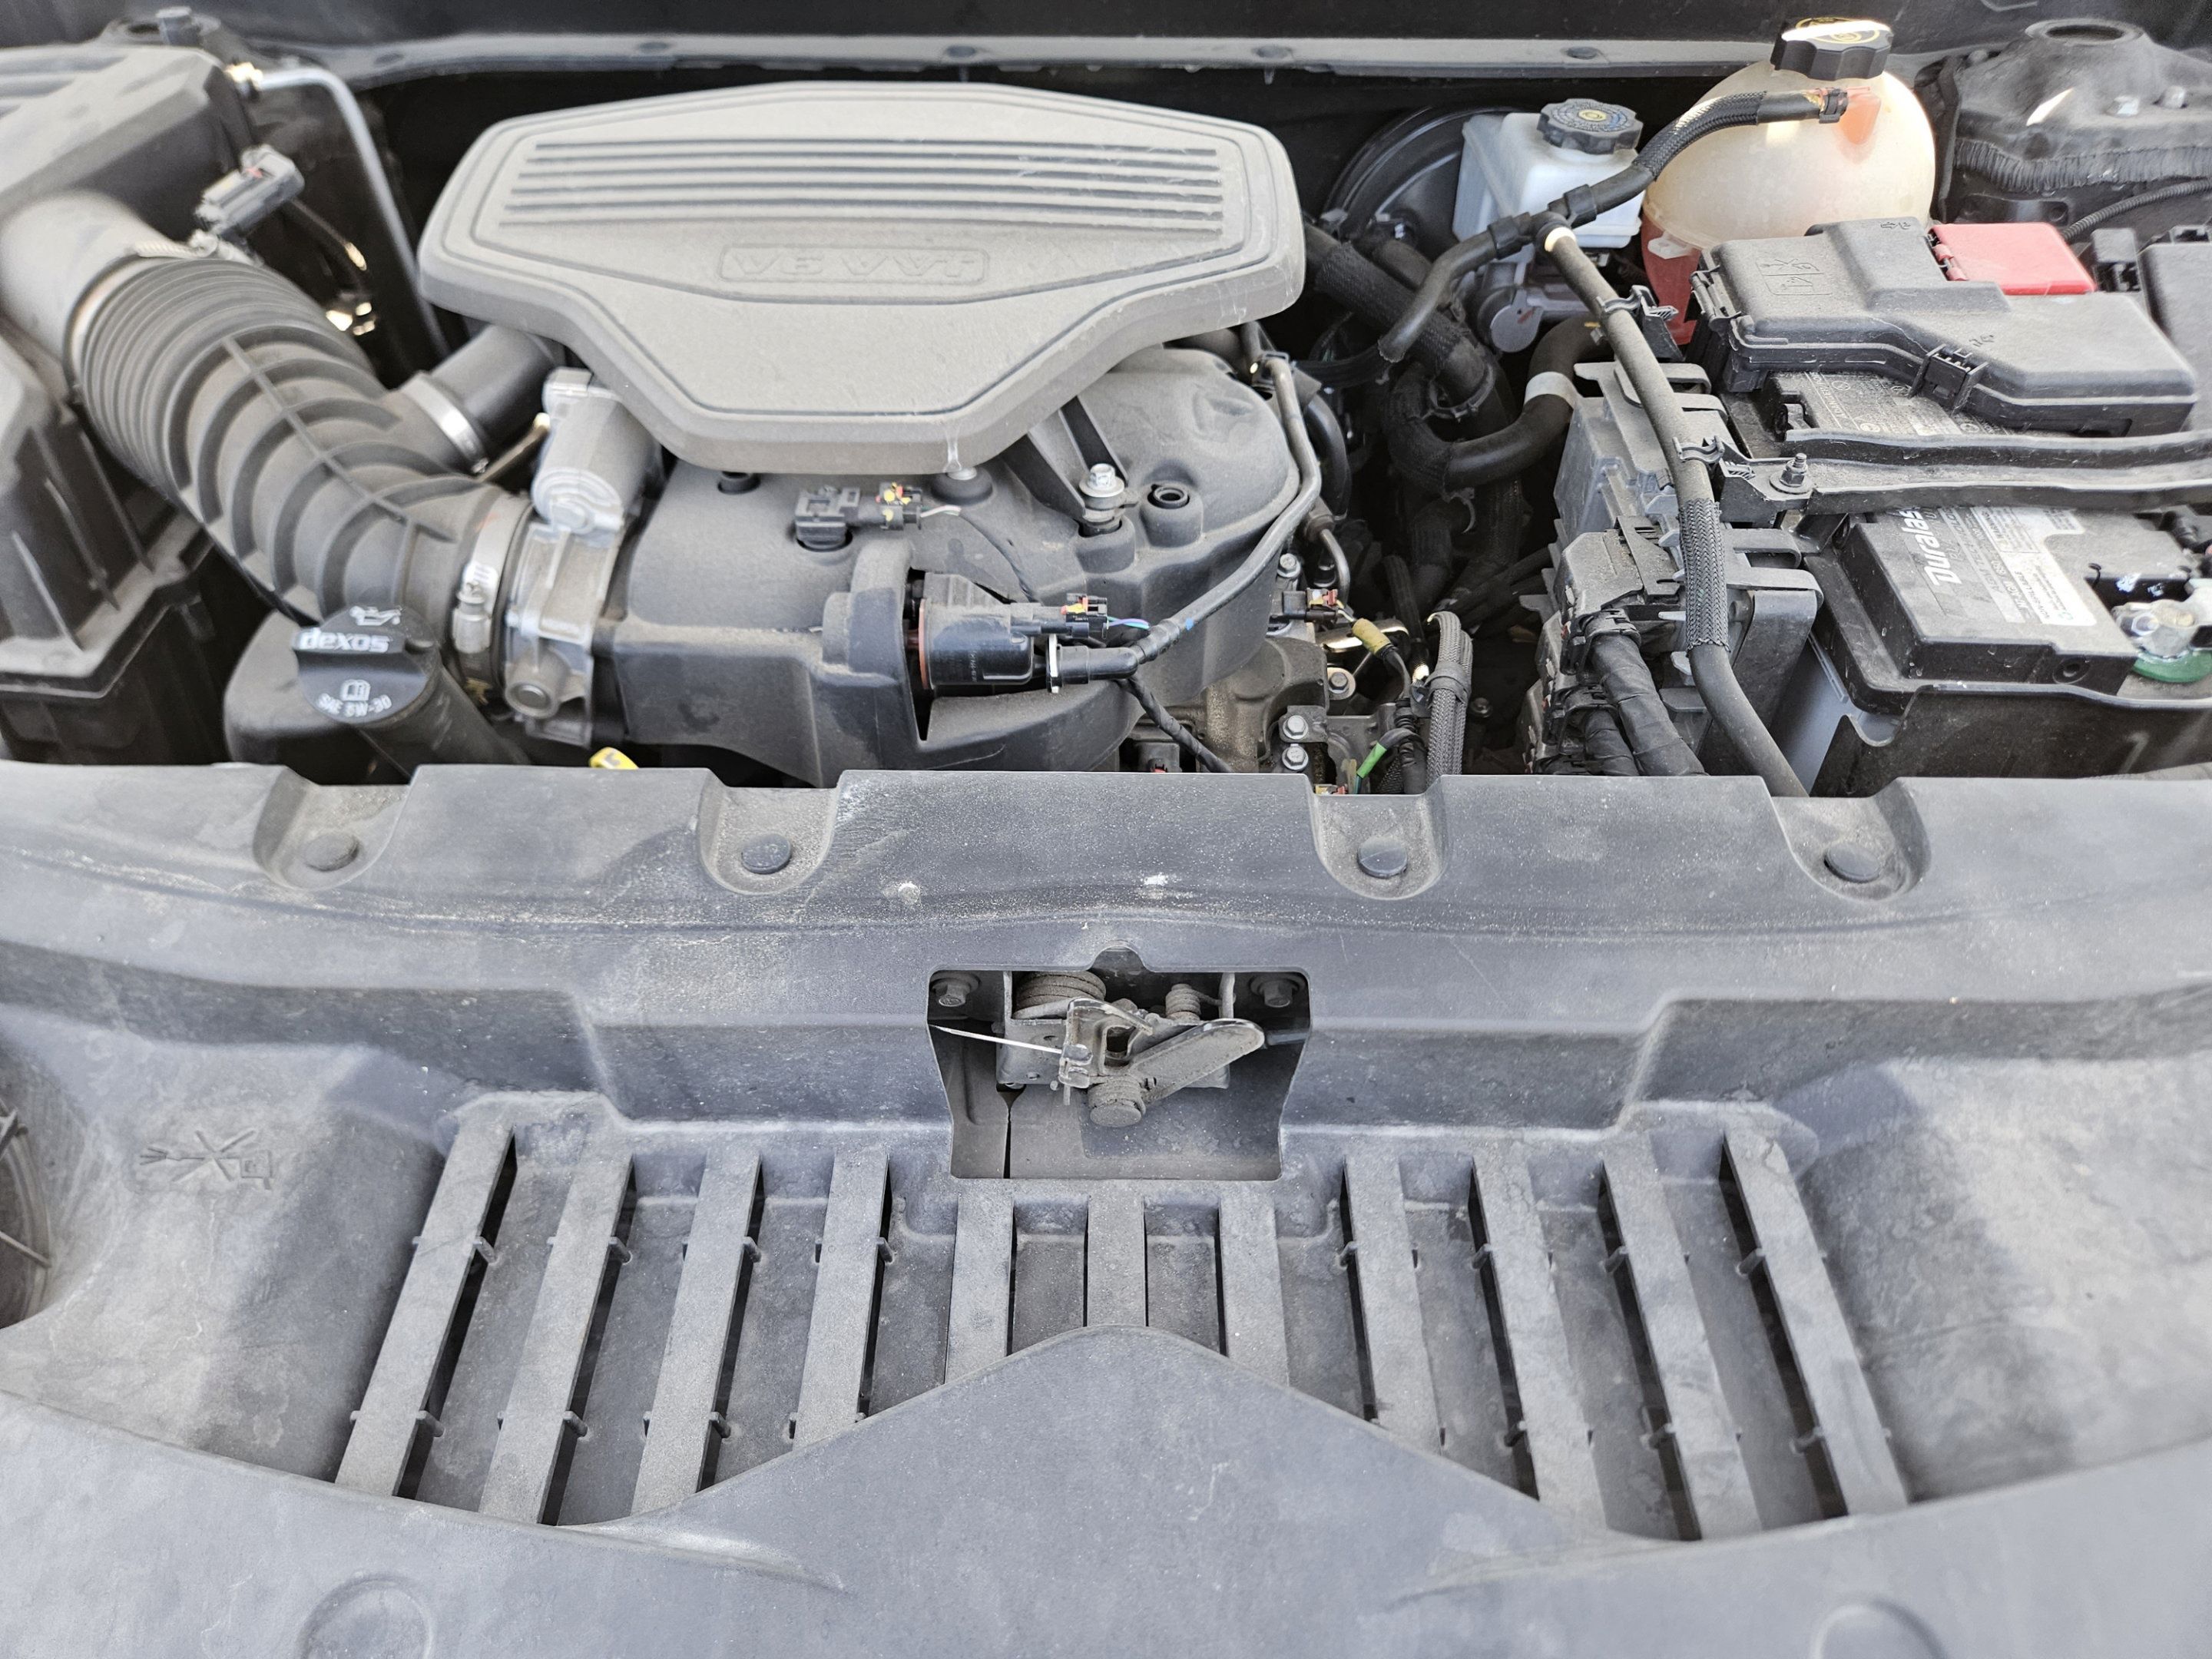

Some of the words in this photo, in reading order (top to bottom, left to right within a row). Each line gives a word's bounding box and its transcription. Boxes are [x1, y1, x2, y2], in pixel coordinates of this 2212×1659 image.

[1899, 508, 1962, 586] Duralas
[1942, 508, 1985, 565] TECHNOLOG
[299, 628, 389, 653] dexos
[318, 693, 343, 714] SAE
